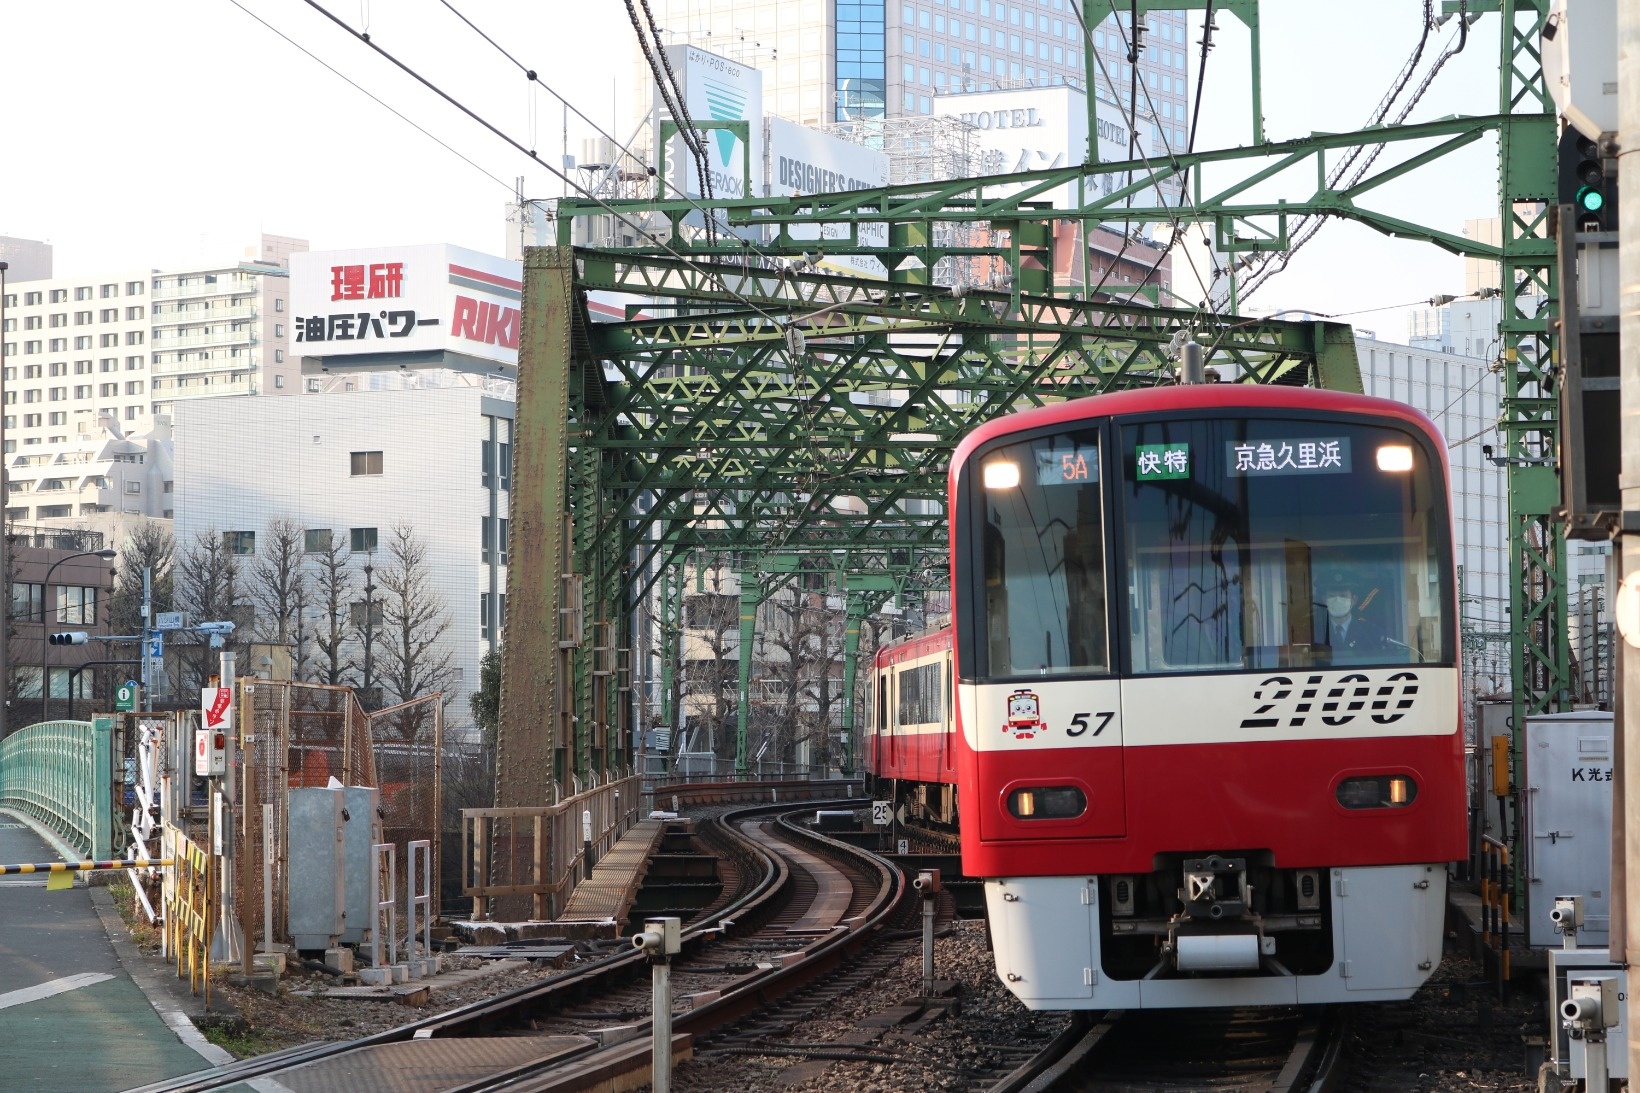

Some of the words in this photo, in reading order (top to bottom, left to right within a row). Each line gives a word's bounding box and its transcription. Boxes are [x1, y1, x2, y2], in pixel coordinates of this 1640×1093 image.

[961, 108, 1041, 130] HOTEL
[1097, 118, 1127, 147] HOTEL
[779, 155, 846, 194] DESIGNER'S
[331, 262, 404, 301] 理研
[295, 310, 439, 342] 油圧パワー
[1062, 453, 1088, 480] 5A
[1137, 450, 1189, 475] 快特
[1234, 440, 1342, 472] 京急久里浜
[1240, 672, 1419, 728] 2100
[1066, 712, 1114, 737] 57
